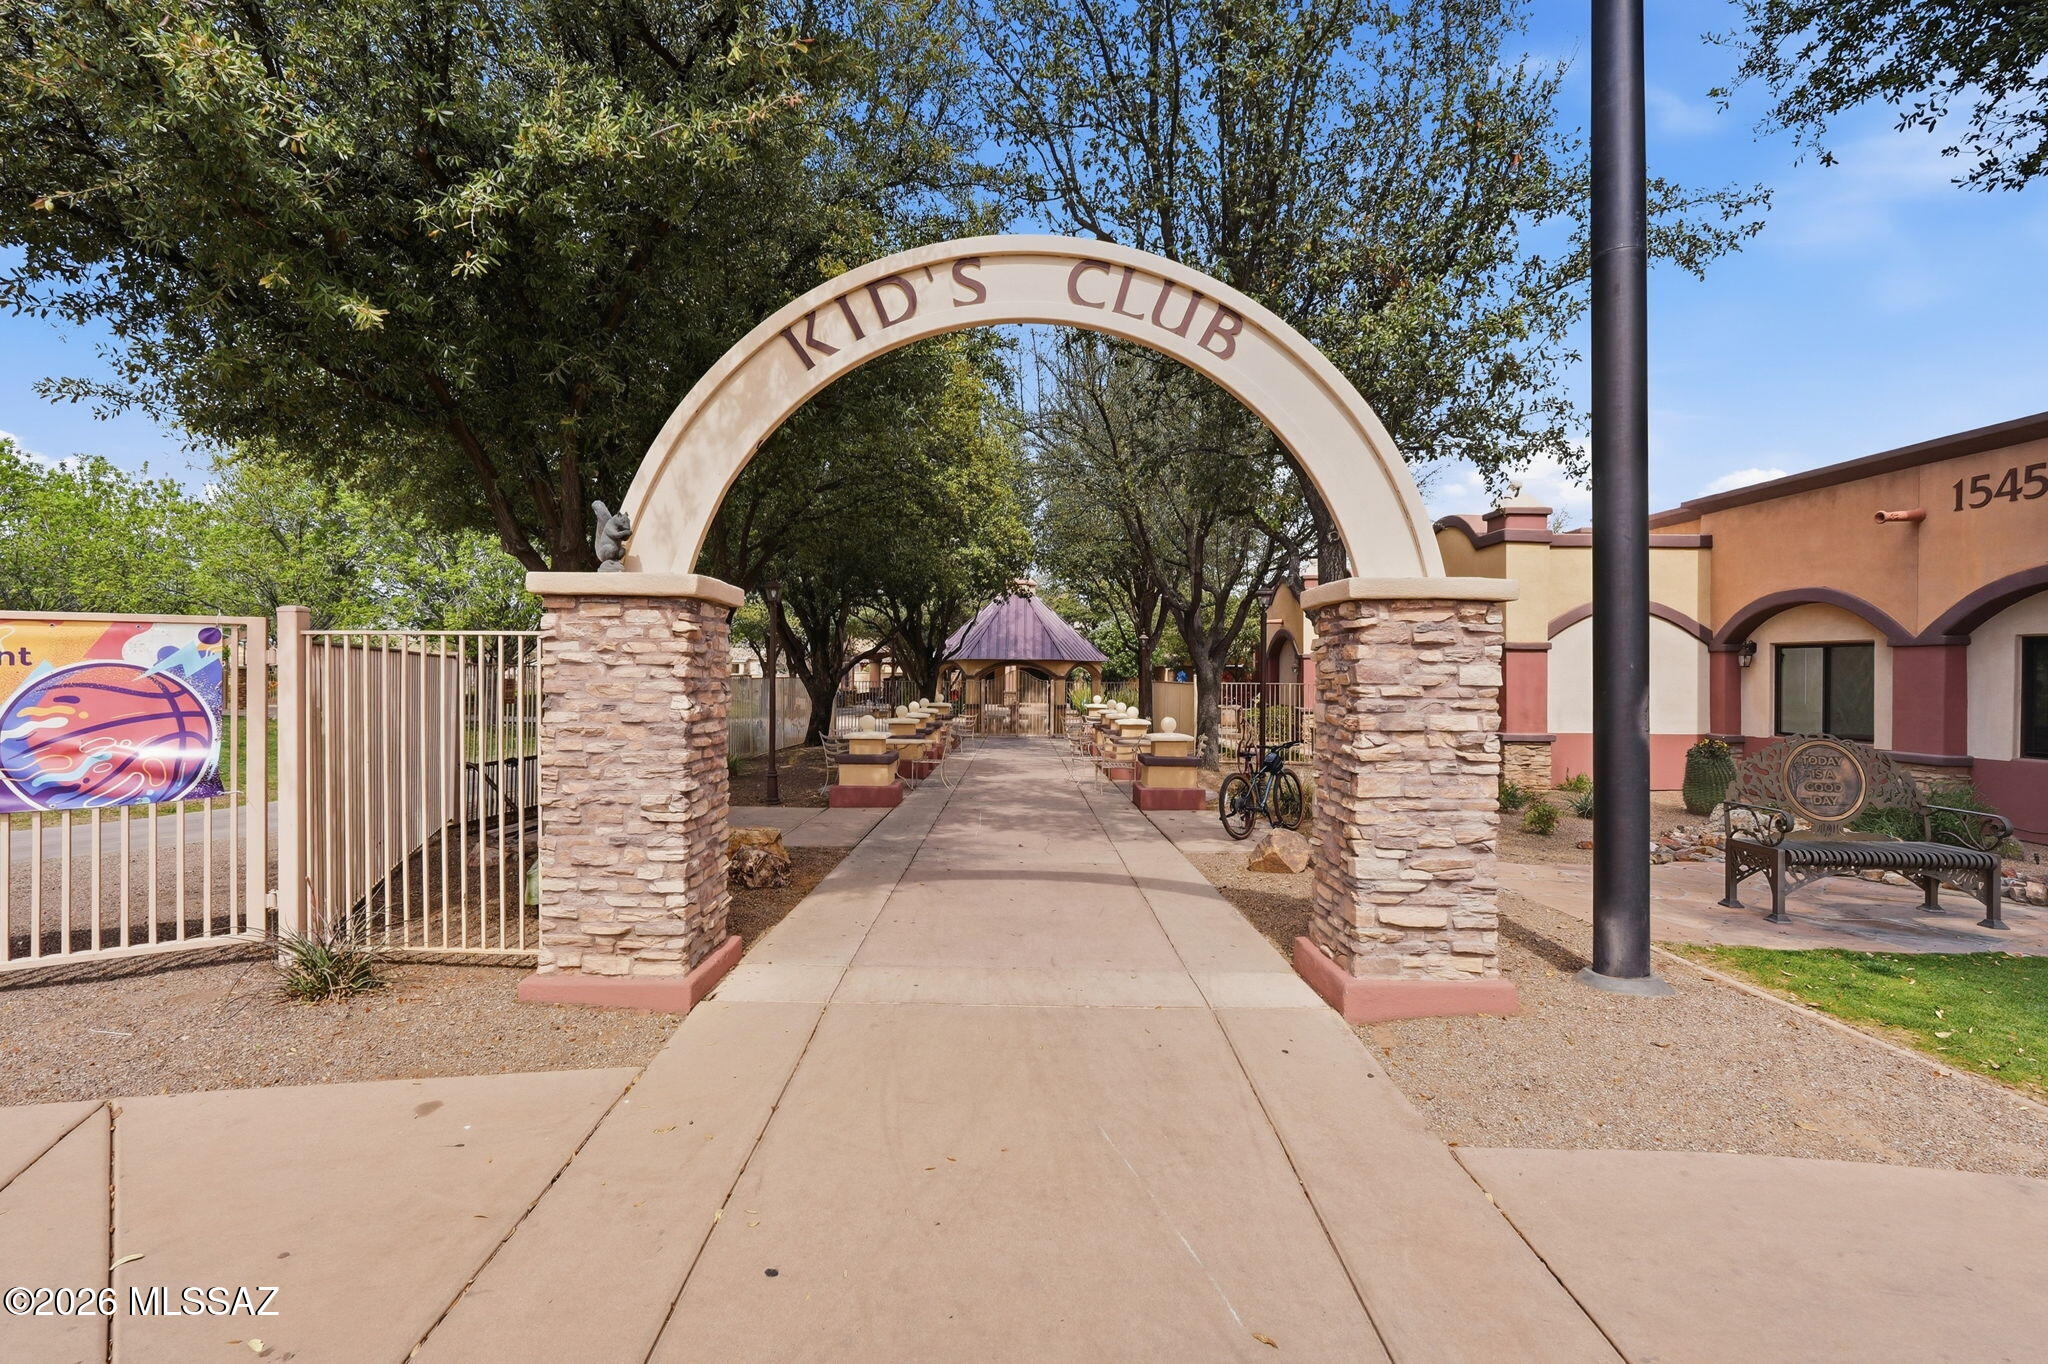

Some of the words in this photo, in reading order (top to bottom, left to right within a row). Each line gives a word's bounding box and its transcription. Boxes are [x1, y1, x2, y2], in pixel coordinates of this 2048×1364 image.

[780, 257, 987, 370] KID'S
[1067, 259, 1244, 360] CLUB
[1953, 462, 2048, 512] 1545
[1801, 755, 1842, 766] TODAY
[1810, 769, 1823, 779] IS
[1825, 769, 1836, 779] A
[1804, 782, 1843, 792] GOOD
[1813, 796, 1838, 806] DAY
